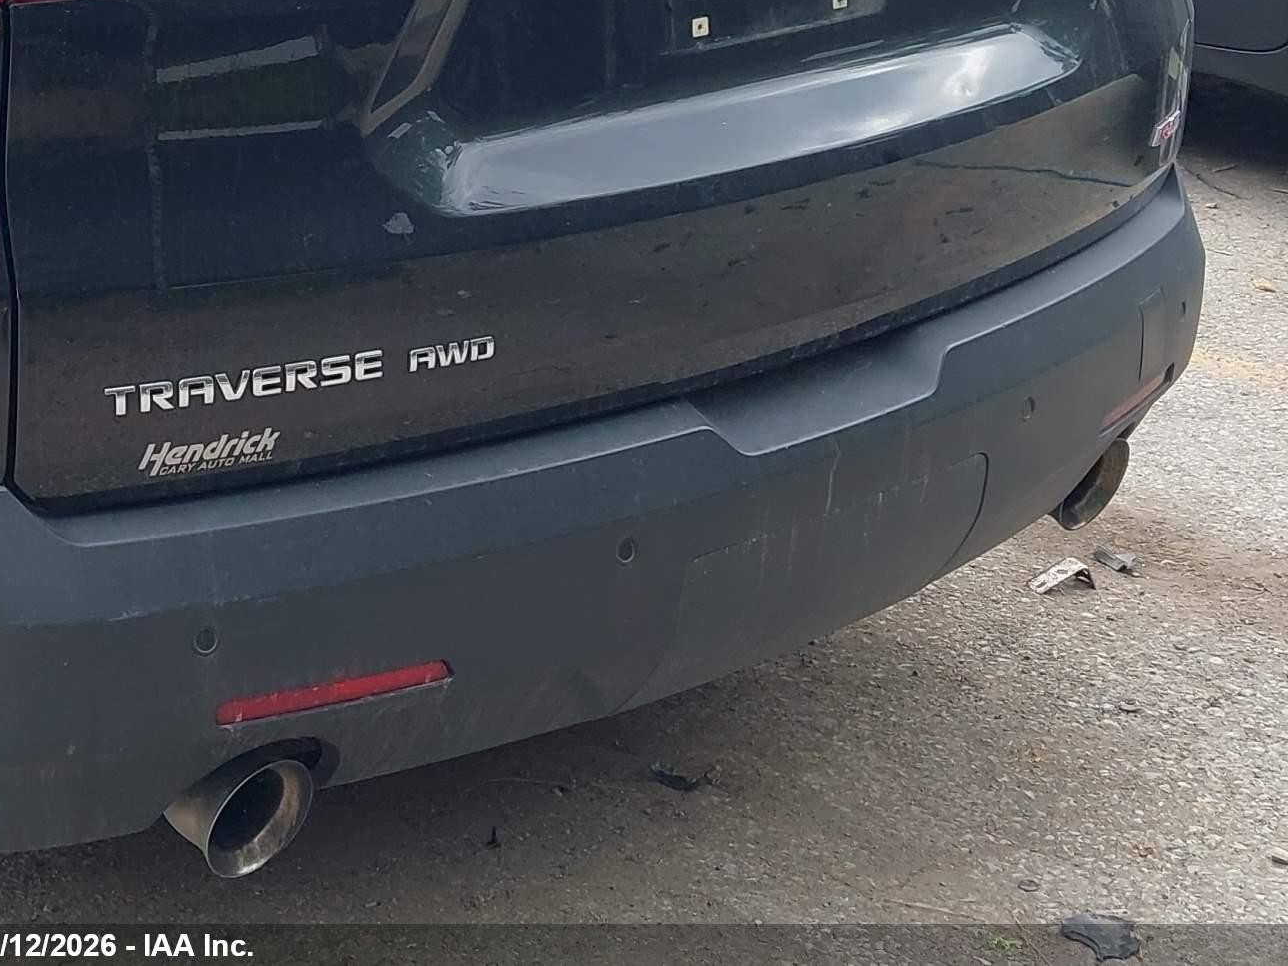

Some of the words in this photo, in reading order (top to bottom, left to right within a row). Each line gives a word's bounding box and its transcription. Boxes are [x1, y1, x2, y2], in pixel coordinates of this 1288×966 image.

[105, 349, 383, 416] TRAVERSE
[409, 335, 495, 372] AWD
[138, 427, 280, 476] Hendrick
[159, 462, 197, 476] CARY
[197, 457, 234, 471] AUTO
[238, 451, 273, 465] MALL
